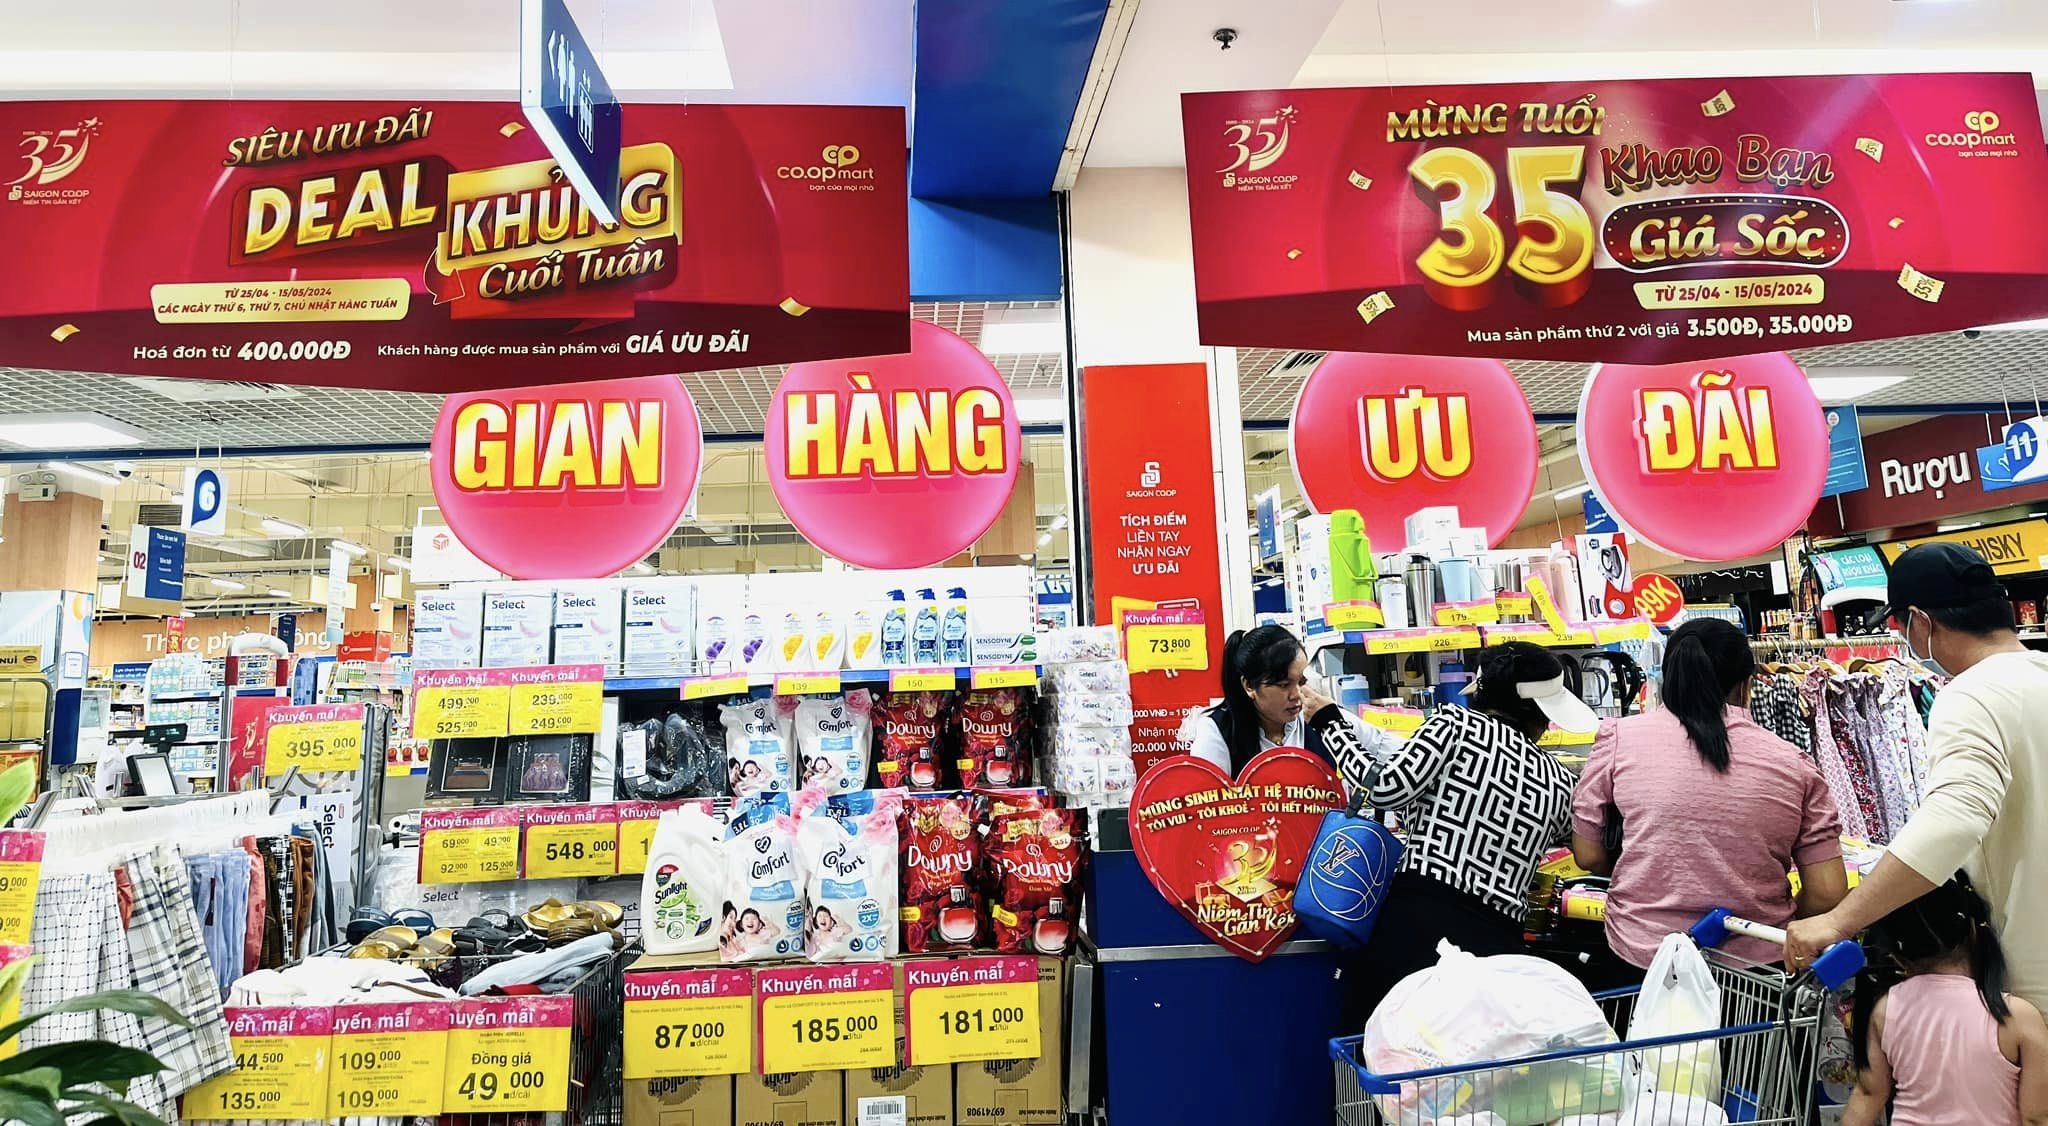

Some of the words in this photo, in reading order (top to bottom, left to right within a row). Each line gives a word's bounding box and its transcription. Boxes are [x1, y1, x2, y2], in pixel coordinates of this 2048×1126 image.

[1387, 98, 1508, 142] MỪNG
[1520, 93, 1605, 137] TUỔI
[222, 126, 305, 167] SIÊU
[312, 120, 367, 154] ƯU
[374, 106, 433, 144] ĐÃI
[1600, 143, 1723, 193] Khao
[1736, 134, 1836, 188] Bạn
[244, 163, 437, 256] DEAL
[1408, 146, 1594, 290] 35
[1629, 213, 1722, 263] Giá
[1733, 209, 1825, 259] Sốc
[479, 250, 565, 298] Cuối
[576, 236, 665, 289] Tuần
[225, 287, 239, 298] TỪ
[240, 288, 269, 299] 25/04
[278, 287, 332, 298] 15/05/2024
[1655, 284, 1676, 303] TỪ
[1678, 284, 1720, 303] 25/04
[1733, 281, 1812, 299] 15/05/2024
[158, 302, 180, 314] CÁC
[181, 301, 211, 314] NGÀY
[213, 302, 234, 312] THỨ
[237, 303, 247, 314] 6,
[249, 301, 271, 312] THỨ
[273, 302, 281, 313] 7,
[284, 300, 306, 311] CHỦ
[308, 299, 336, 313] NHẬT
[337, 298, 368, 310] HÀNG
[1466, 329, 1501, 343] Mua
[1504, 327, 1532, 342] sản
[1536, 325, 1579, 345] phẩm
[1584, 322, 1613, 340] thứ
[1615, 326, 1626, 338] 2
[1629, 322, 1652, 337] với
[1655, 322, 1680, 341] giá
[1686, 323, 1764, 346] 3.500Đ,
[1767, 313, 1853, 341] 35.000Đ
[133, 345, 169, 360] Hoá
[172, 345, 208, 360] đơn
[211, 345, 232, 359] từ
[237, 340, 353, 361] 400.000Đ
[377, 342, 421, 356] Khách
[424, 342, 459, 360] hàng
[461, 342, 496, 358] được
[499, 346, 530, 356] mua
[532, 343, 556, 356] sản
[558, 342, 598, 360] phẩm
[601, 342, 620, 355] với
[625, 330, 665, 354] GIÁ
[671, 331, 709, 353] ƯU
[709, 328, 750, 354] ĐÃI
[785, 373, 1008, 488] HÀNG
[1634, 370, 1783, 474] ĐÃI
[453, 398, 664, 492] GIAN
[1360, 386, 1476, 484] ƯU
[2009, 430, 2033, 461] 11
[1880, 452, 1972, 499] Rượu
[199, 480, 217, 512] 6
[1119, 510, 1151, 527] TÍCH
[1154, 510, 1187, 526] ĐIỂM
[1127, 526, 1156, 543] LIỀN
[1159, 530, 1180, 542] TAY
[1117, 545, 1155, 563] NHẬN
[1158, 545, 1191, 559] NGAY
[1963, 532, 2027, 567] HISKY
[133, 552, 147, 570] 02
[1132, 563, 1153, 575] ƯU
[1156, 560, 1179, 574] ĐÃI
[421, 600, 457, 612] Select
[491, 599, 527, 611] Select
[562, 597, 598, 609] Select
[632, 594, 669, 607] Select
[1634, 576, 1679, 619] 99K
[1125, 613, 1163, 625] Khuyến
[1166, 610, 1185, 623] mãi
[975, 637, 1013, 646] SENSODYNE
[976, 652, 1014, 661] SENSODYNE
[418, 672, 462, 687] Khuyến
[511, 669, 555, 684] Khuyến
[269, 711, 313, 725] Khuyến
[962, 717, 1013, 738] Downy
[886, 720, 936, 739] Downy
[1138, 728, 1165, 738] Nhận
[286, 737, 357, 758] 395.000
[1132, 742, 1167, 752] 20.000
[1169, 741, 1191, 751] VNĐ
[1139, 795, 1182, 821] MỪNG
[1184, 790, 1220, 807] SINH
[1221, 783, 1261, 807] NHẬT
[1264, 782, 1283, 799] HỆ
[1285, 784, 1336, 803] THỐNG
[424, 814, 468, 830] Khuyến
[526, 811, 571, 826] Khuyến
[575, 810, 596, 822] mãi
[619, 806, 663, 820] Khuyến
[1146, 819, 1168, 832] TÔI
[1168, 815, 1187, 829] VUI
[1197, 806, 1218, 824] TÔI
[1260, 802, 1280, 814] TÔI
[1281, 800, 1302, 814] HẾT
[323, 804, 338, 849] Select
[1211, 827, 1238, 836] SAIGON
[545, 840, 616, 862] 548.000
[908, 845, 973, 875] Downy
[751, 851, 791, 880] Comfort
[1002, 858, 1073, 884] Downy
[422, 890, 459, 903] Select
[655, 881, 688, 905] Sunlight
[1197, 904, 1242, 924] Niềm
[1247, 902, 1273, 919] Tin
[1223, 915, 1261, 936] Gắn
[761, 974, 823, 995] Khuyến
[828, 971, 858, 992] mãi
[908, 965, 970, 987] Khuyến
[974, 965, 1003, 982] mãi
[624, 978, 681, 1000] Khuyến
[686, 978, 716, 996] mãi
[261, 1010, 296, 1033] mãi
[377, 1009, 410, 1029] mãi
[502, 1007, 535, 1026] mãi
[939, 1007, 1025, 1035] 181.000
[654, 1022, 725, 1049] 87.000
[792, 1015, 878, 1043] 185.000
[339, 1051, 401, 1071] 109.000
[472, 1050, 508, 1071] Đồng
[512, 1050, 532, 1069] giá
[220, 1091, 282, 1110] 135.000
[337, 1089, 399, 1109] 109.000
[966, 1107, 1006, 1117] 69741908
